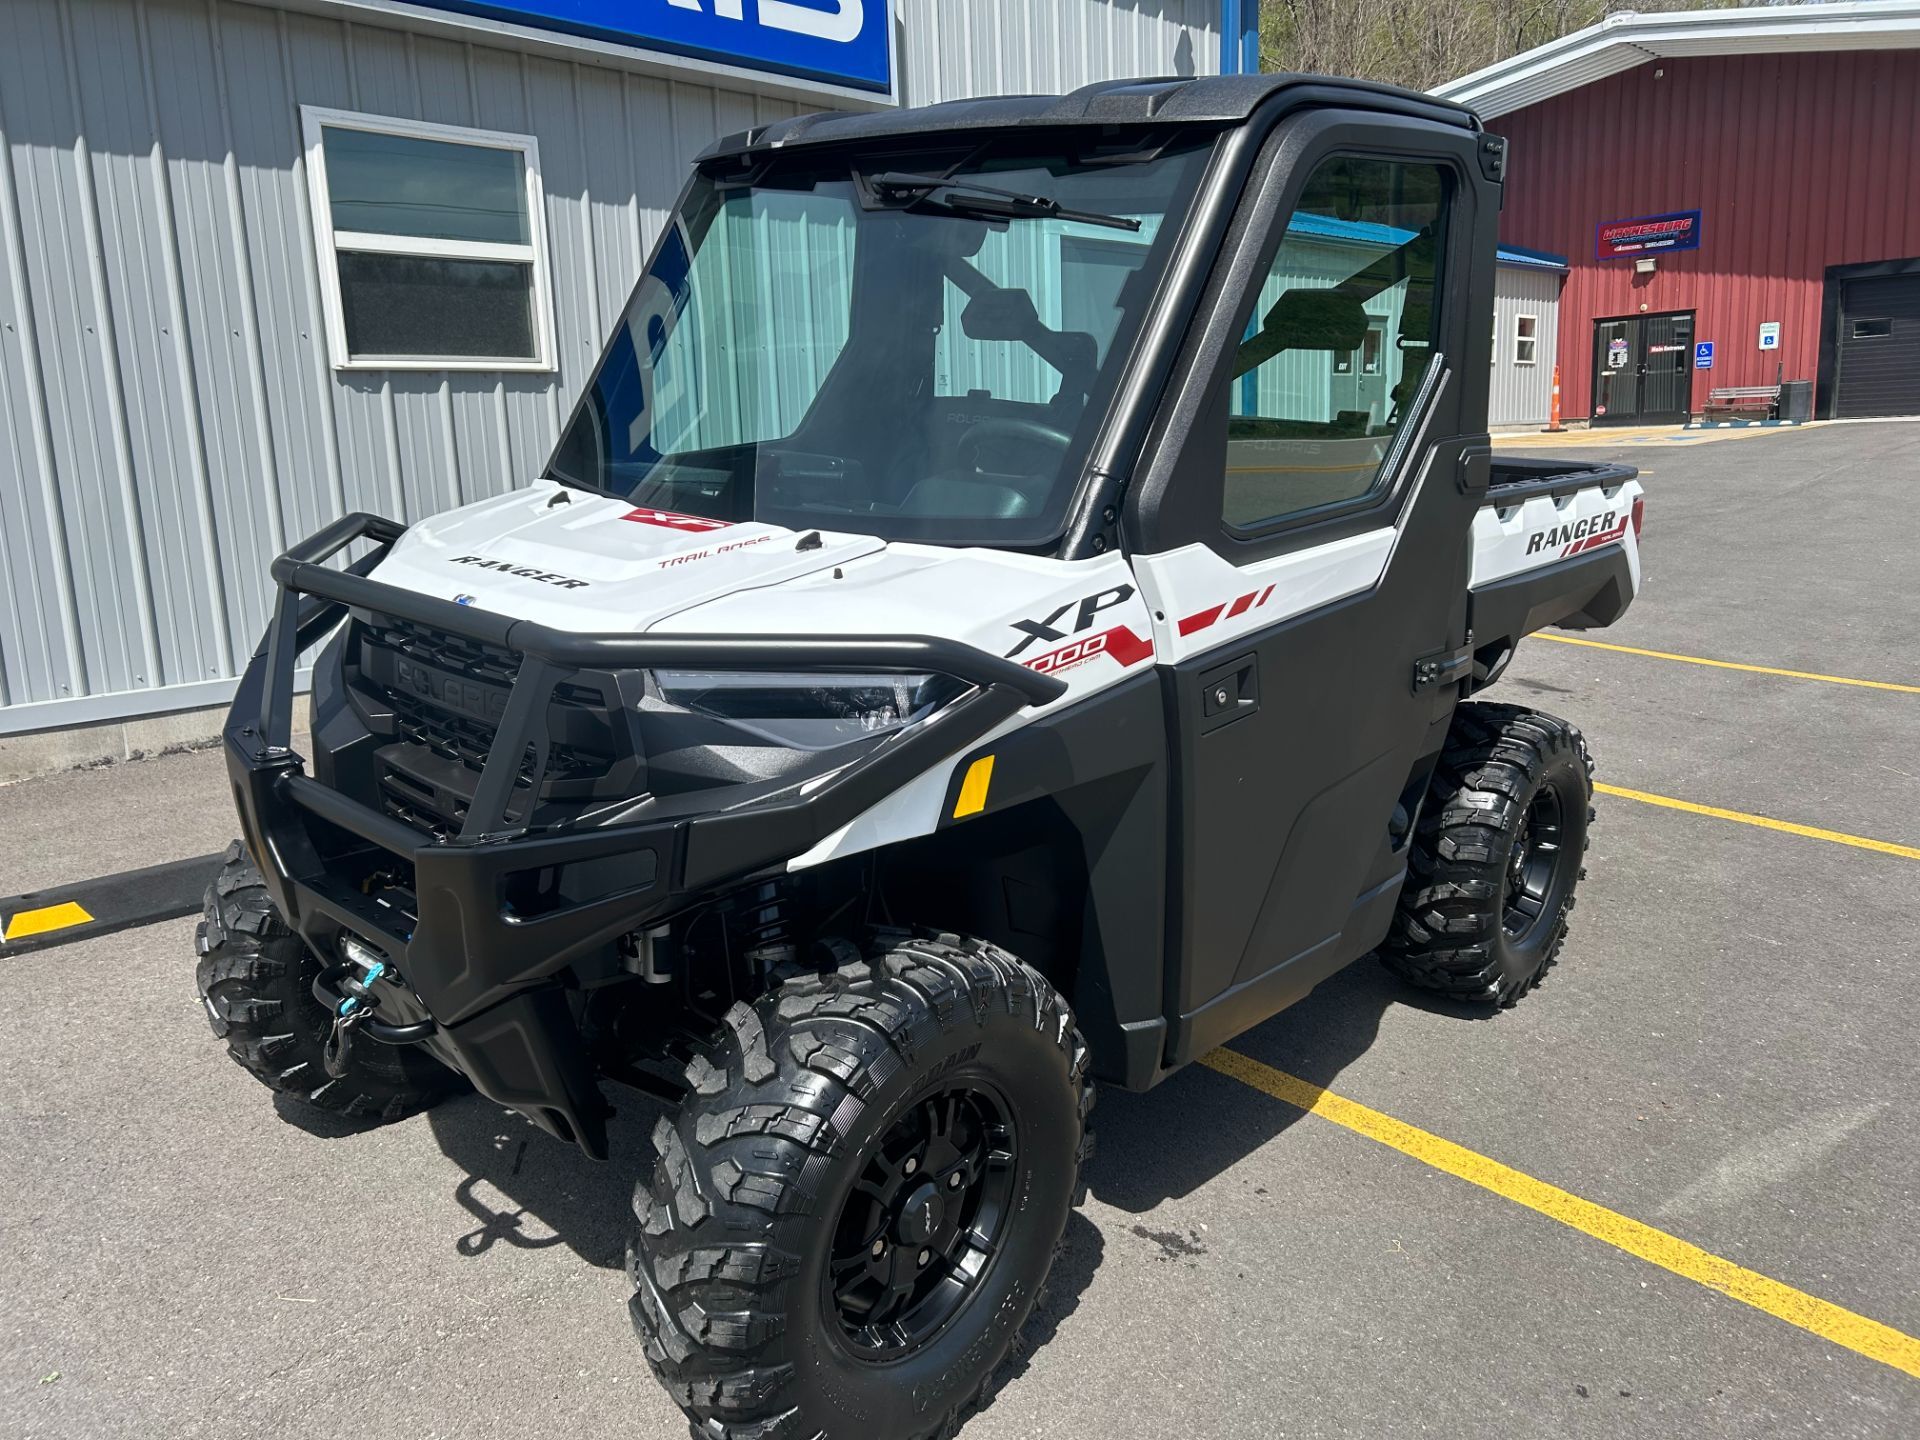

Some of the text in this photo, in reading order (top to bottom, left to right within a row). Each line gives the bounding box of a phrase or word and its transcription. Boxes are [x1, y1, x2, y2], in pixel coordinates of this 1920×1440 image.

[1603, 218, 1693, 240] WAYNESBURG
[1651, 345, 1663, 353] Main
[631, 512, 726, 528] XP
[1526, 511, 1616, 556] RANGER
[448, 555, 591, 590] RANGER
[658, 549, 714, 569] TRAIL
[1004, 583, 1136, 659] XP
[1025, 634, 1108, 673] 000
